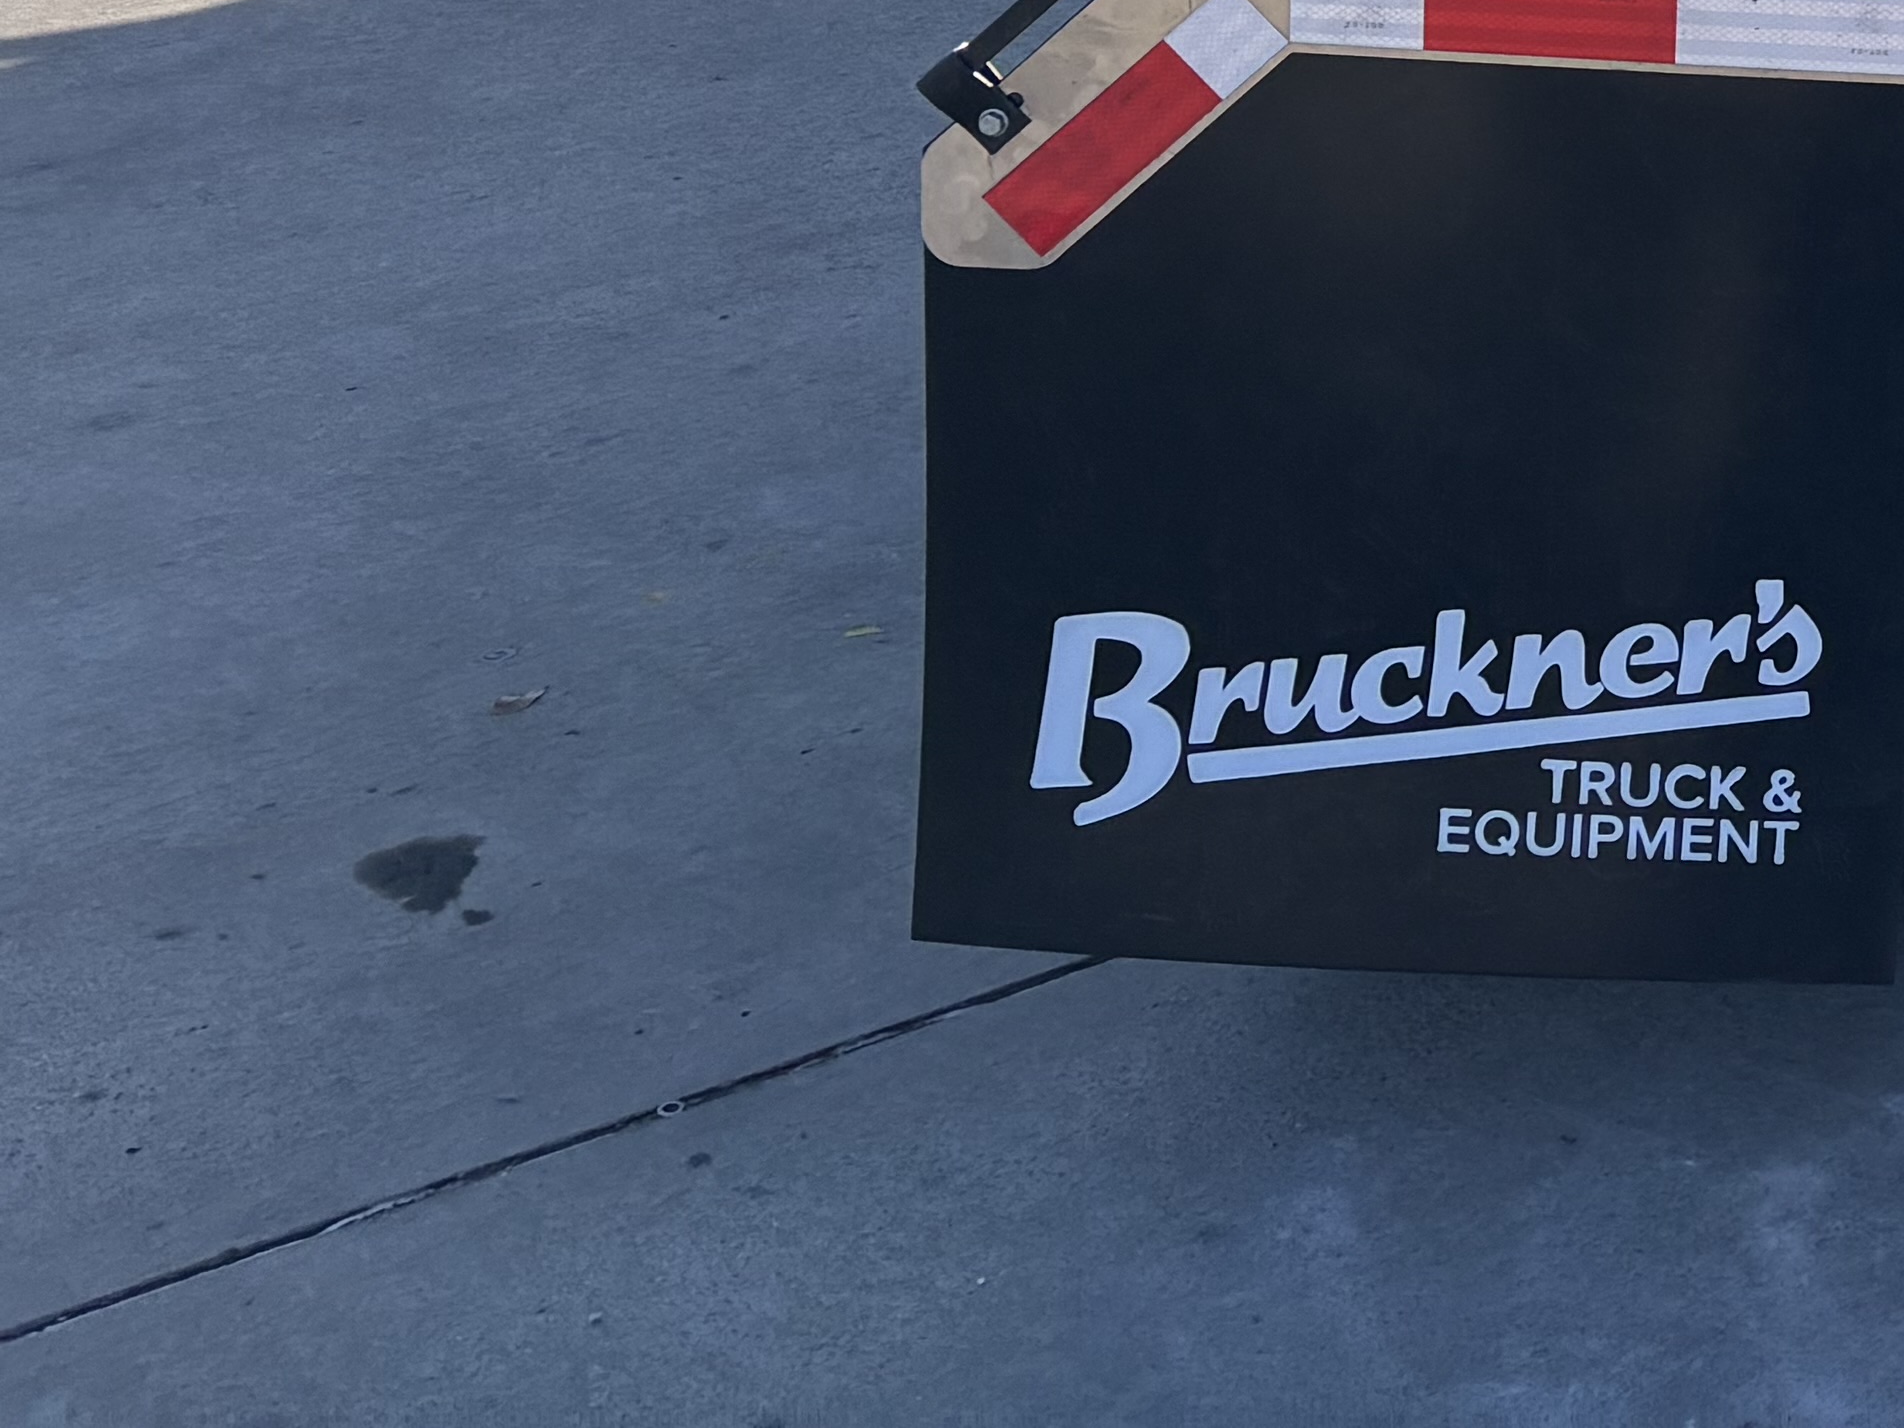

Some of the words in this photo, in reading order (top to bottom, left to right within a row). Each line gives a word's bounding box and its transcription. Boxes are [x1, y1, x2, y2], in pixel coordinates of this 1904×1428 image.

[1030, 580, 1823, 826] Bruckner's
[1541, 758, 1747, 812] TRUCK
[1762, 768, 1802, 814] &
[1436, 808, 1800, 865] EQUIPMENT
